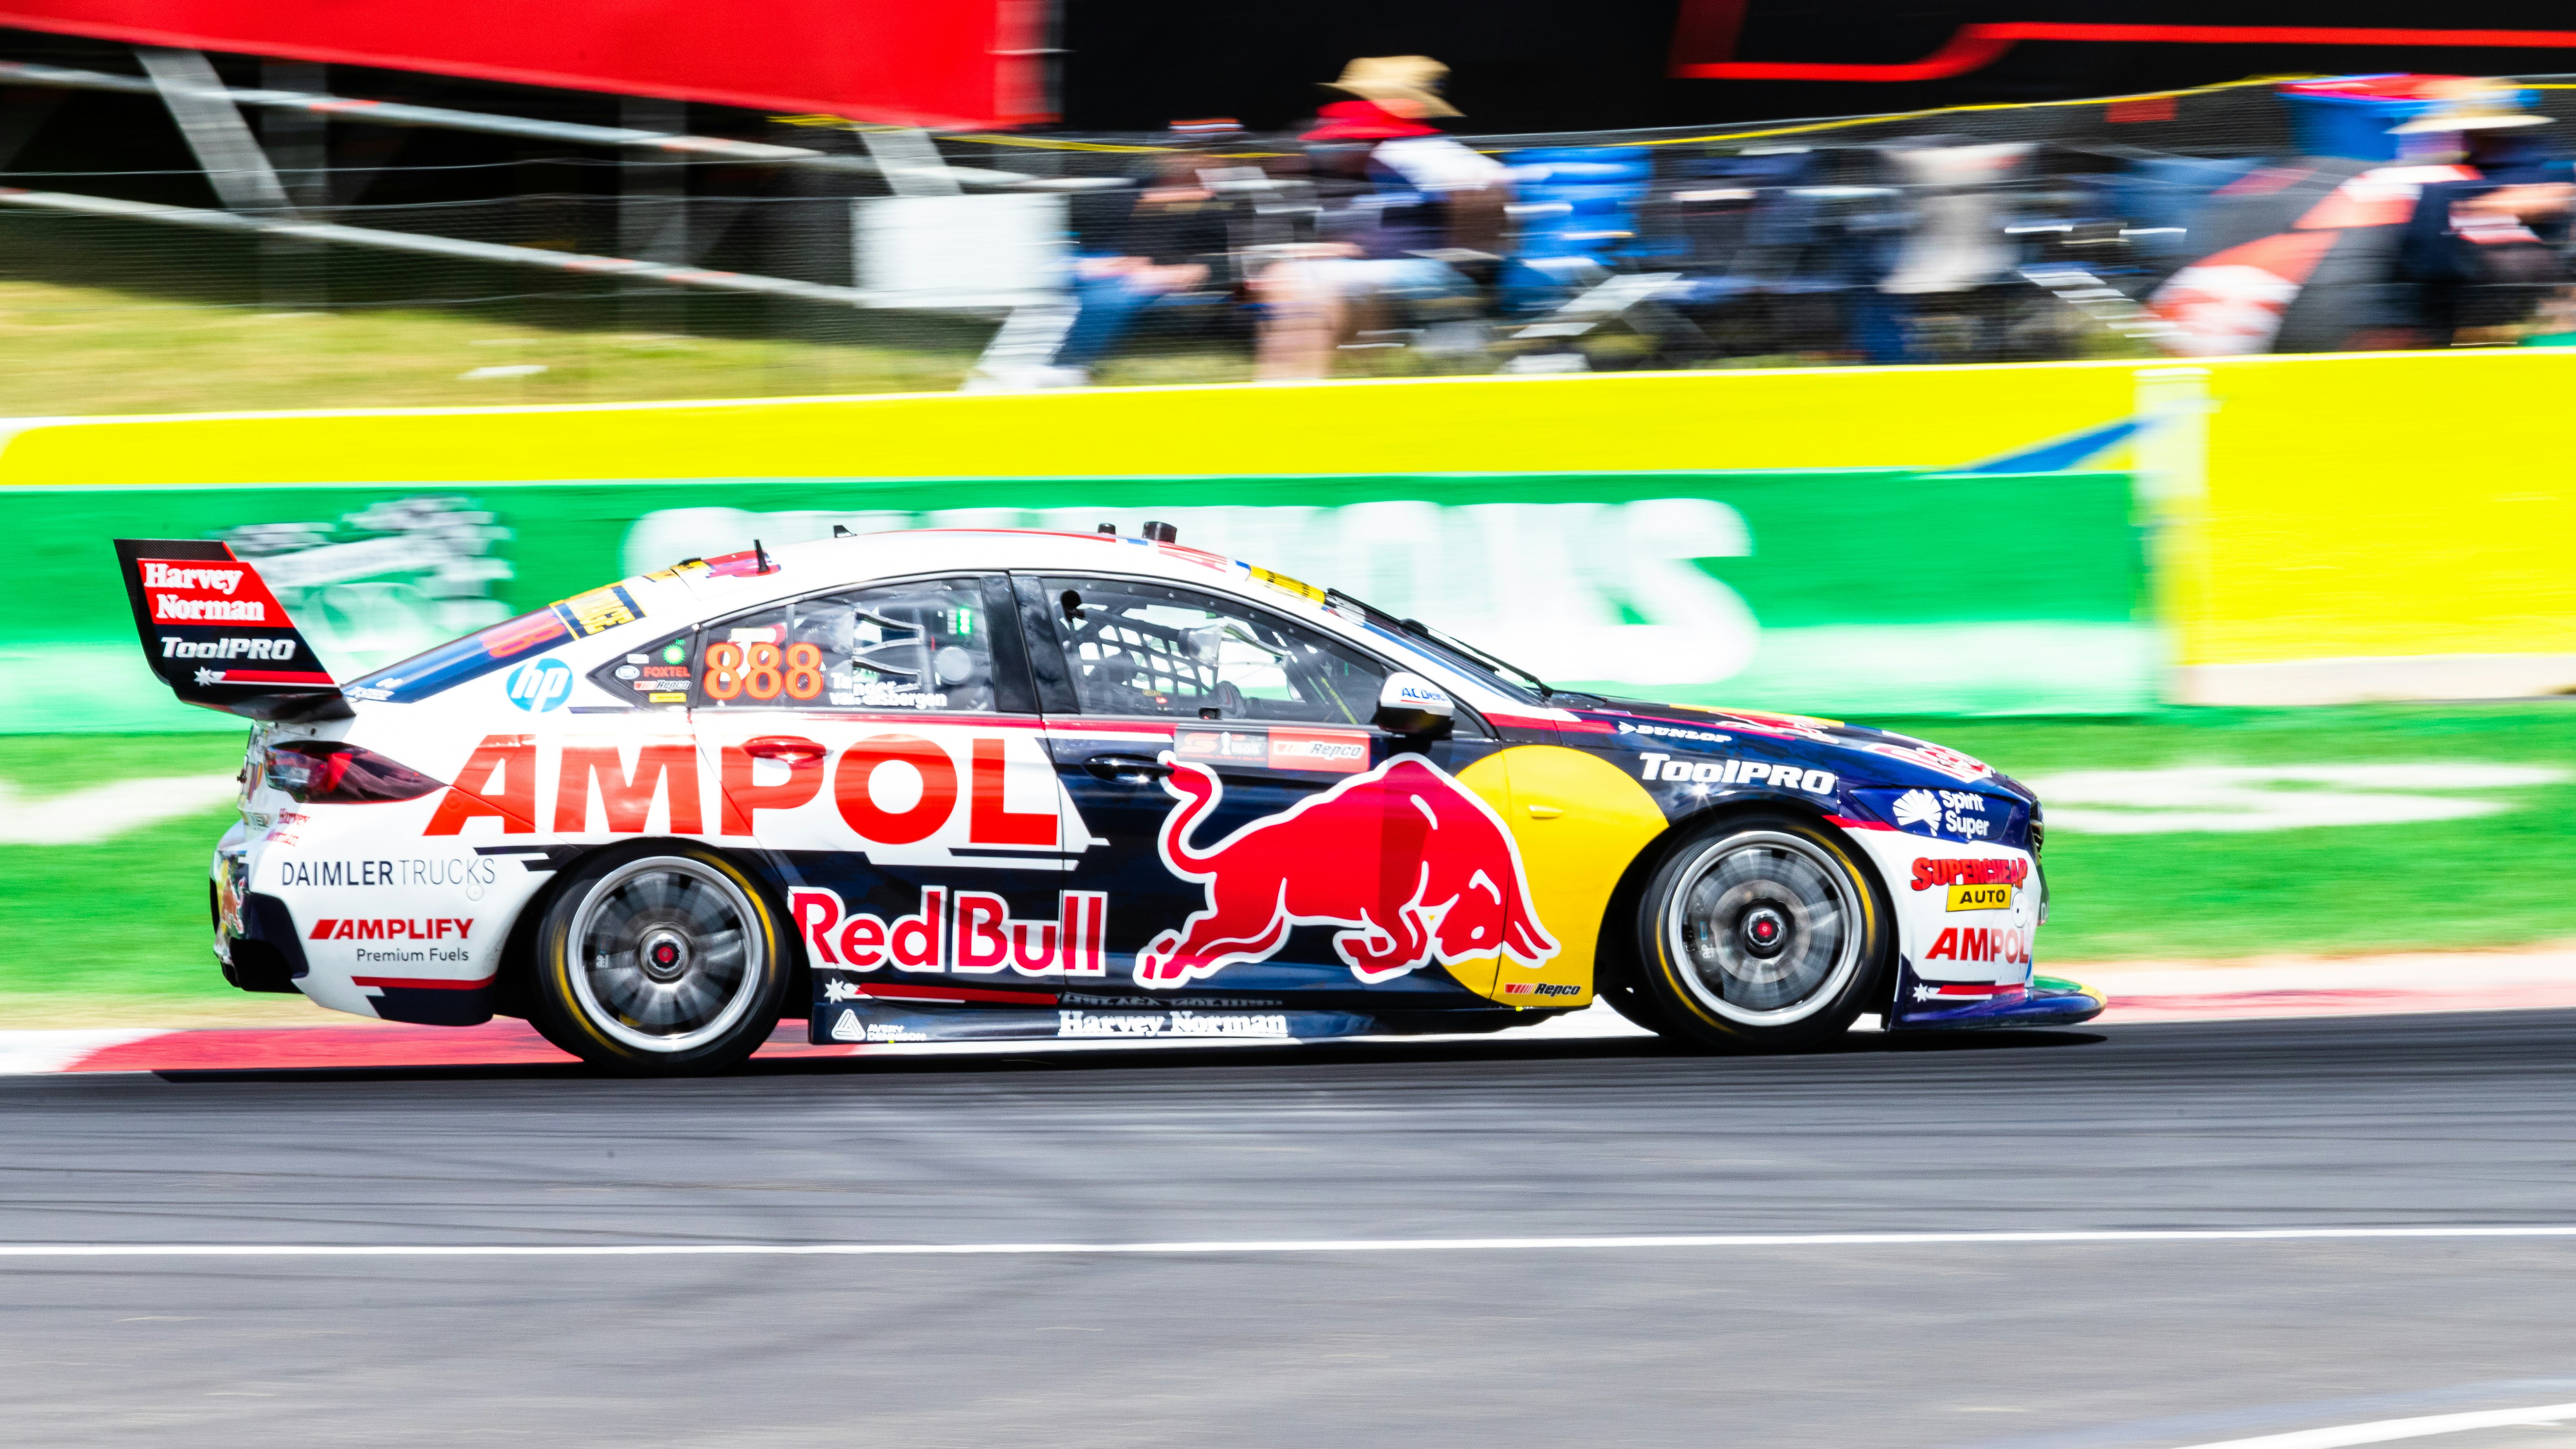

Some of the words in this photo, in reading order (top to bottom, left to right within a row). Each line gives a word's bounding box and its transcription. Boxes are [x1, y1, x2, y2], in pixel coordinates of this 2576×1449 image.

[144, 563, 244, 594] Harvey
[156, 594, 265, 621] Norman
[161, 637, 296, 661] ToolPRO
[643, 666, 691, 678] FOXTEL
[703, 642, 824, 701] 888
[511, 659, 571, 713] hp
[657, 680, 691, 691] Repco
[1636, 724, 1732, 742] DUNLOP
[1310, 743, 1363, 758] Repco
[1639, 752, 1836, 795] ToolPRO
[422, 734, 1058, 845] AMPOL
[1939, 790, 1985, 814] Spirit
[1945, 810, 1990, 839] Super
[1911, 857, 2028, 891] SUPERCHEAP
[1960, 889, 2006, 904] AUTO
[334, 919, 474, 940] AMPLIFY
[788, 886, 947, 973] Red
[952, 890, 1108, 977] Bull
[357, 948, 424, 961] Premium
[429, 947, 469, 961] Fuels
[1925, 927, 2029, 964] AMPOL
[1534, 983, 1582, 997] Repco
[867, 1024, 905, 1033] AVERY
[1058, 1010, 1165, 1036] Harvey
[1170, 1010, 1288, 1035] Norman
[867, 1032, 927, 1041] DENNISON
